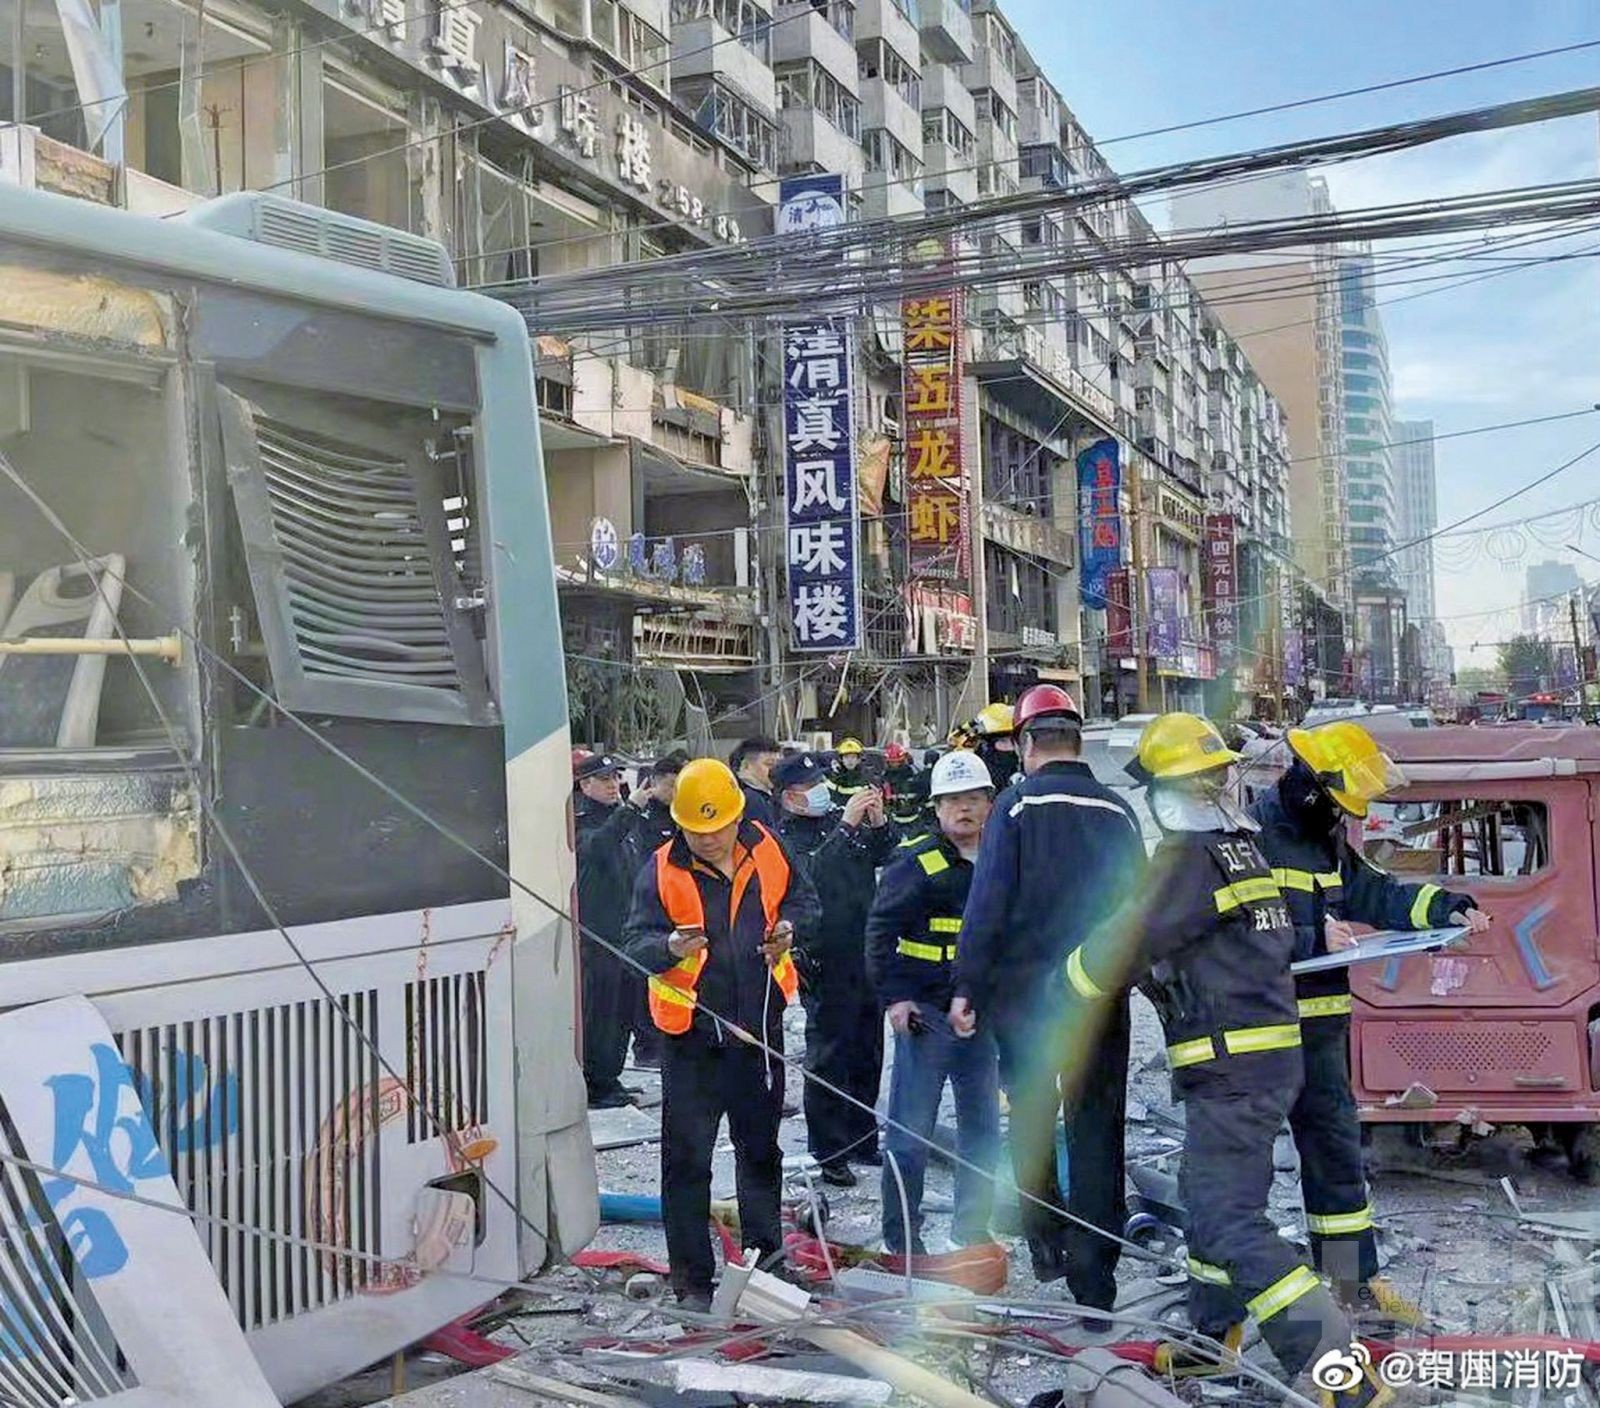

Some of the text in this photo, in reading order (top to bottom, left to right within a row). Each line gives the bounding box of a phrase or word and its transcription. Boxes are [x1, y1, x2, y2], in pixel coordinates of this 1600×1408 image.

[784, 325, 849, 641] 清真风味楼
[904, 299, 960, 542] 柒五龙虾
